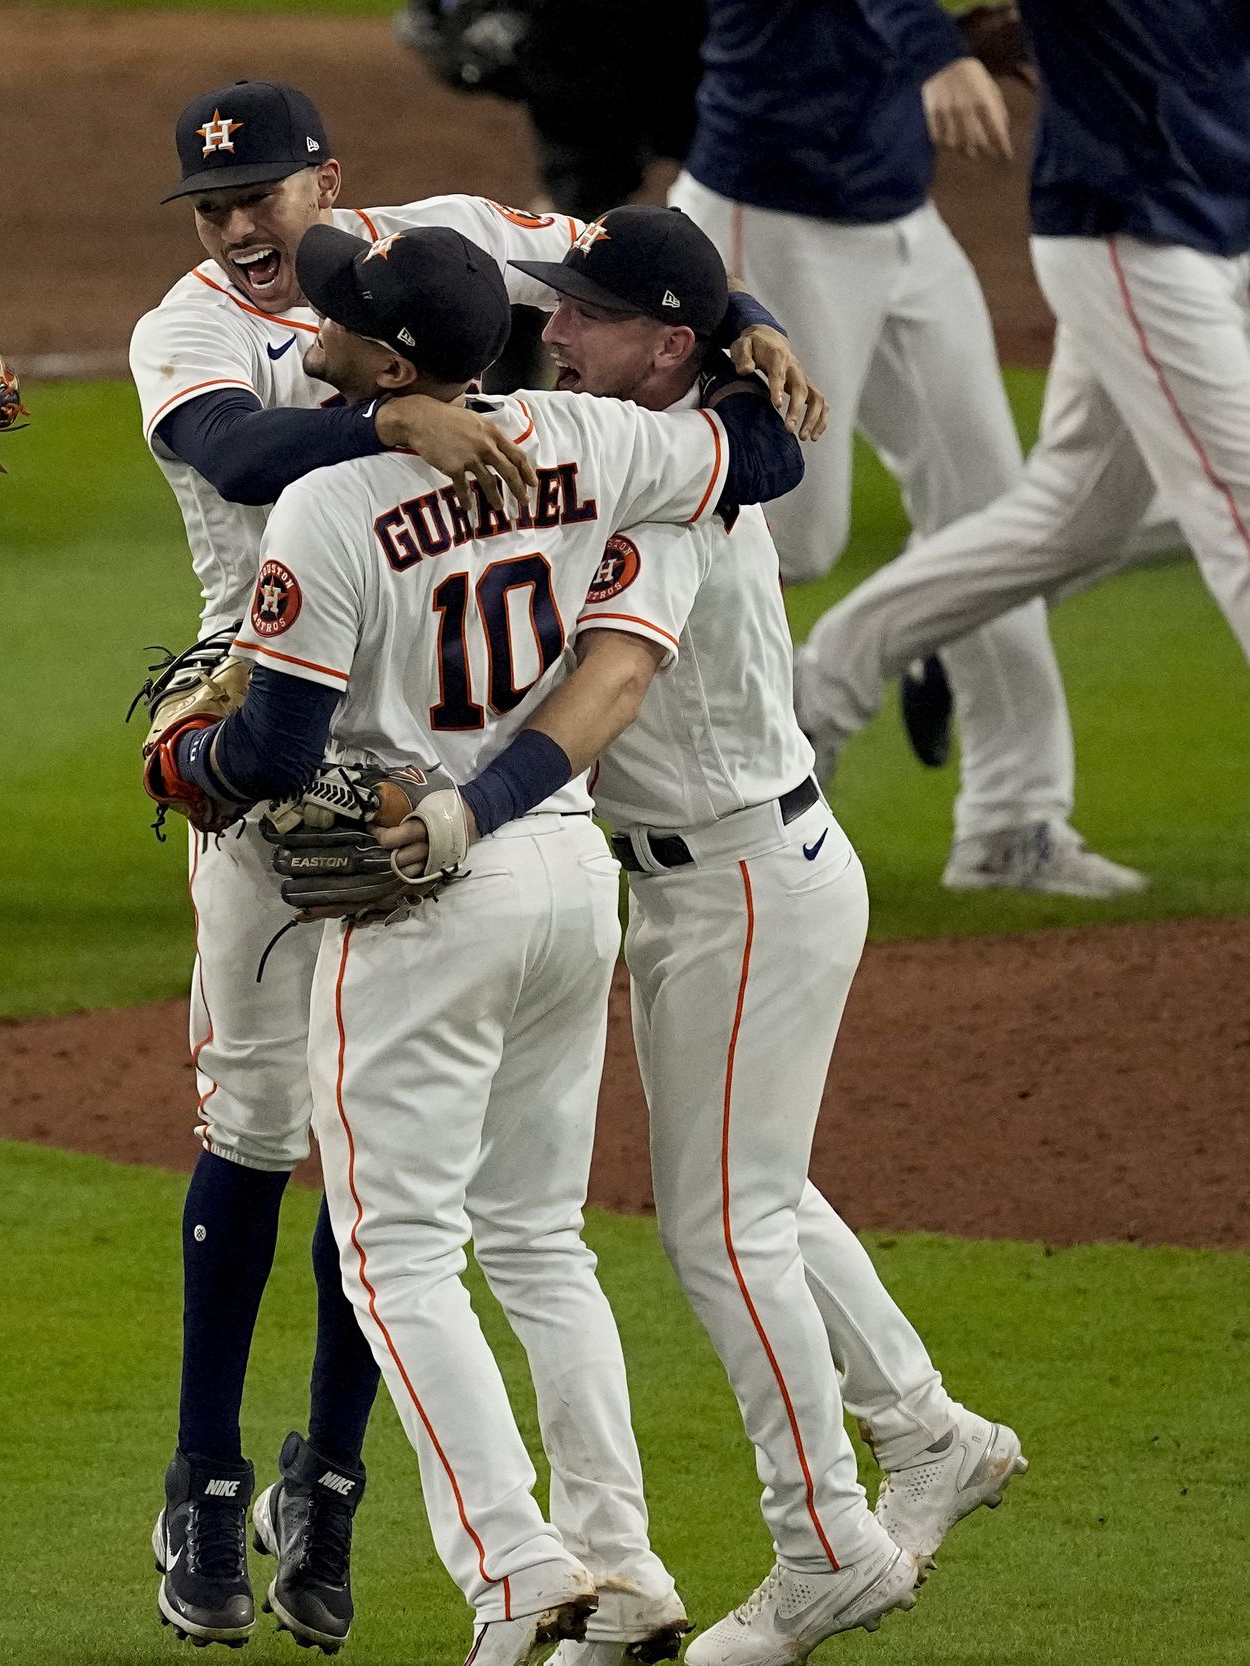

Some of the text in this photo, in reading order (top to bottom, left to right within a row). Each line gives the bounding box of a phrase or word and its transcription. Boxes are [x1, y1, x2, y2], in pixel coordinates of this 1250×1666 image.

[202, 118, 235, 153] H
[574, 222, 608, 254] H
[261, 585, 282, 613] H
[253, 613, 286, 633] ASTROS
[429, 552, 565, 731] 10
[290, 857, 350, 868] EASTON
[204, 1479, 241, 1497] NIKE
[317, 1470, 356, 1497] NIKE
